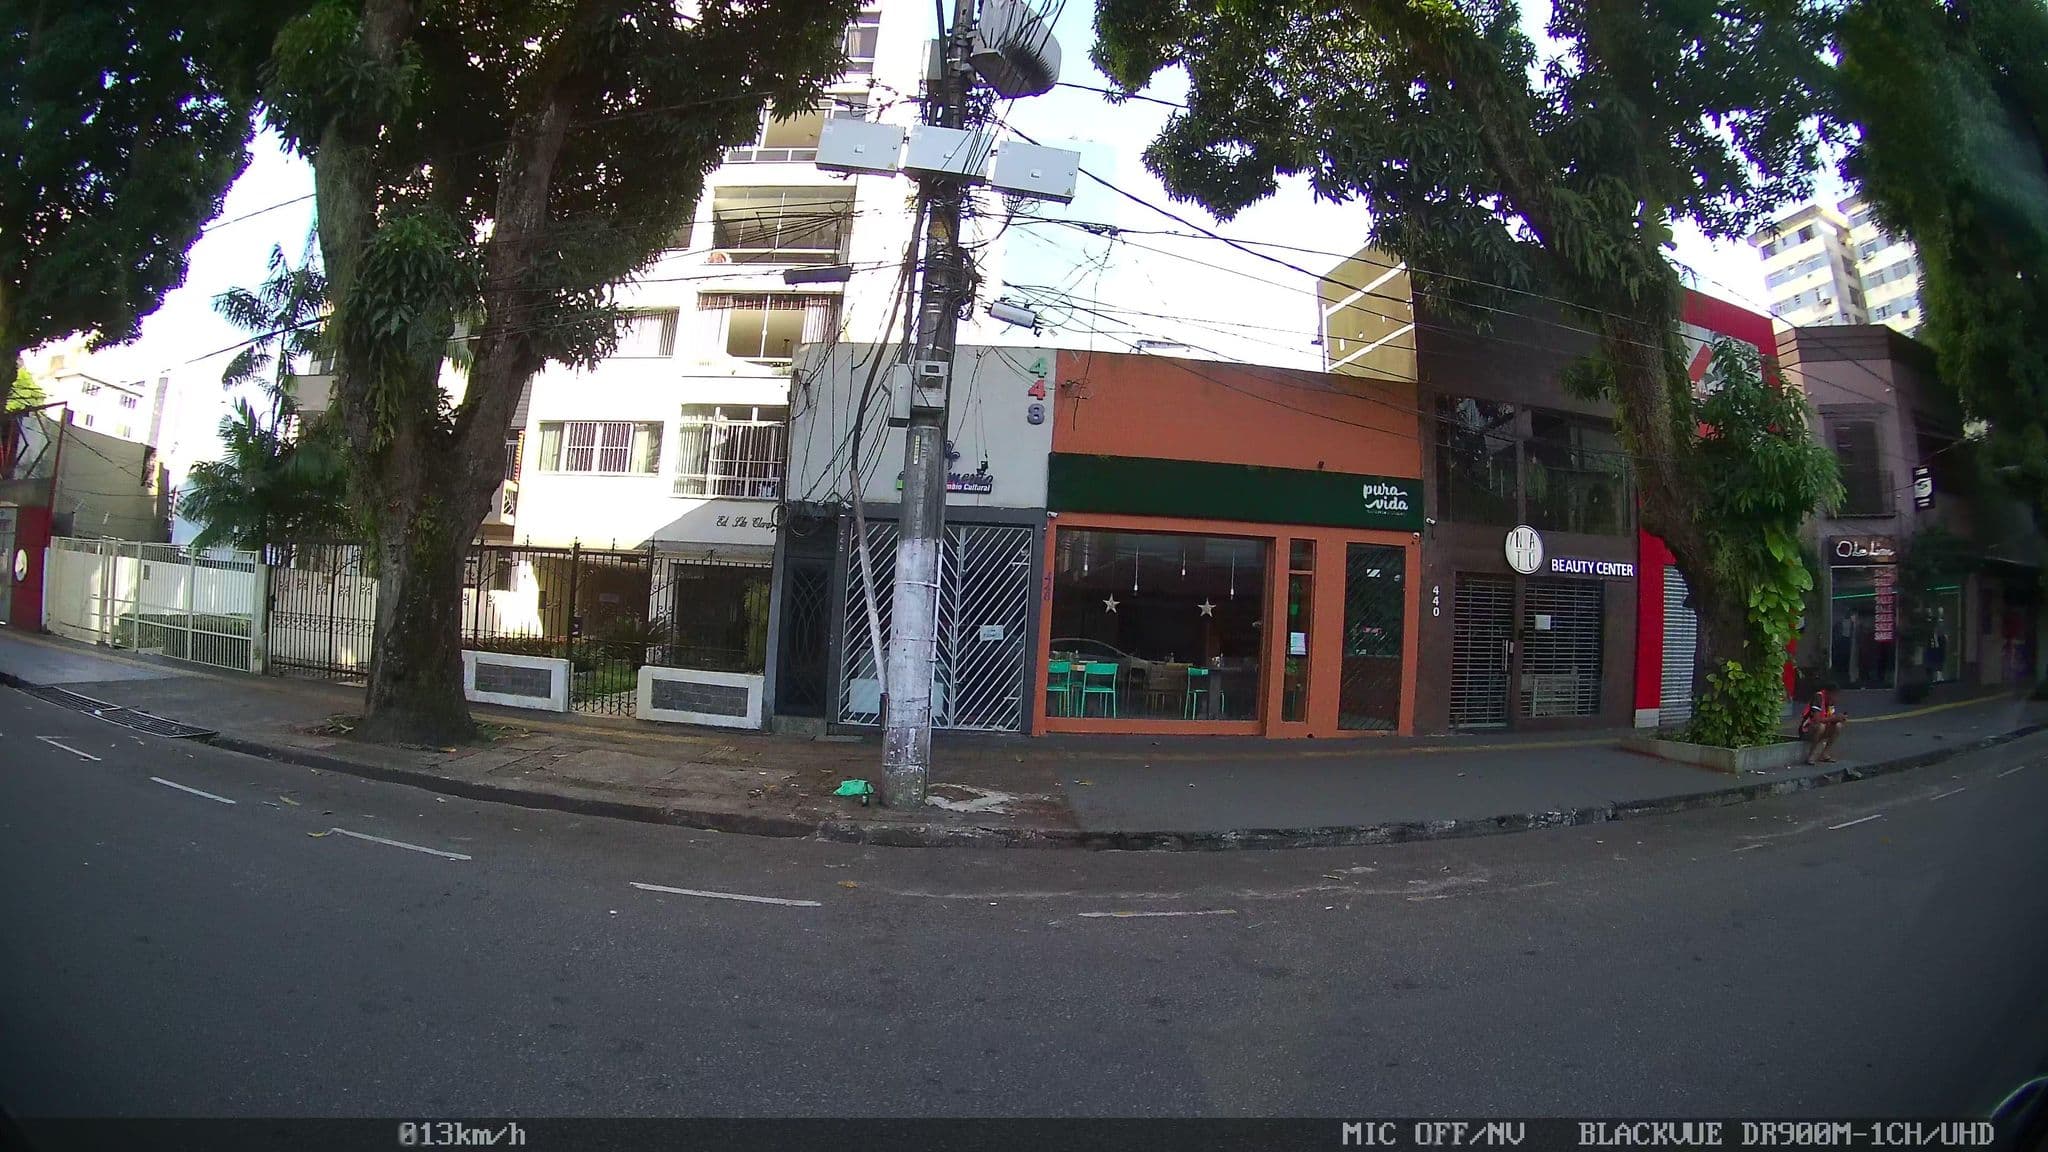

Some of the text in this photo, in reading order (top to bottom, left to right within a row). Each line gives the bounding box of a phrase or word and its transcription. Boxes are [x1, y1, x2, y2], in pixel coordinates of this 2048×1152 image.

[1026, 356, 1048, 425] 448
[963, 483, 991, 492] Cultural
[1362, 482, 1408, 499] pura
[1364, 496, 1409, 510] vida
[1551, 558, 1634, 577] BEAUTY CENTER
[1432, 585, 1440, 617] 440
